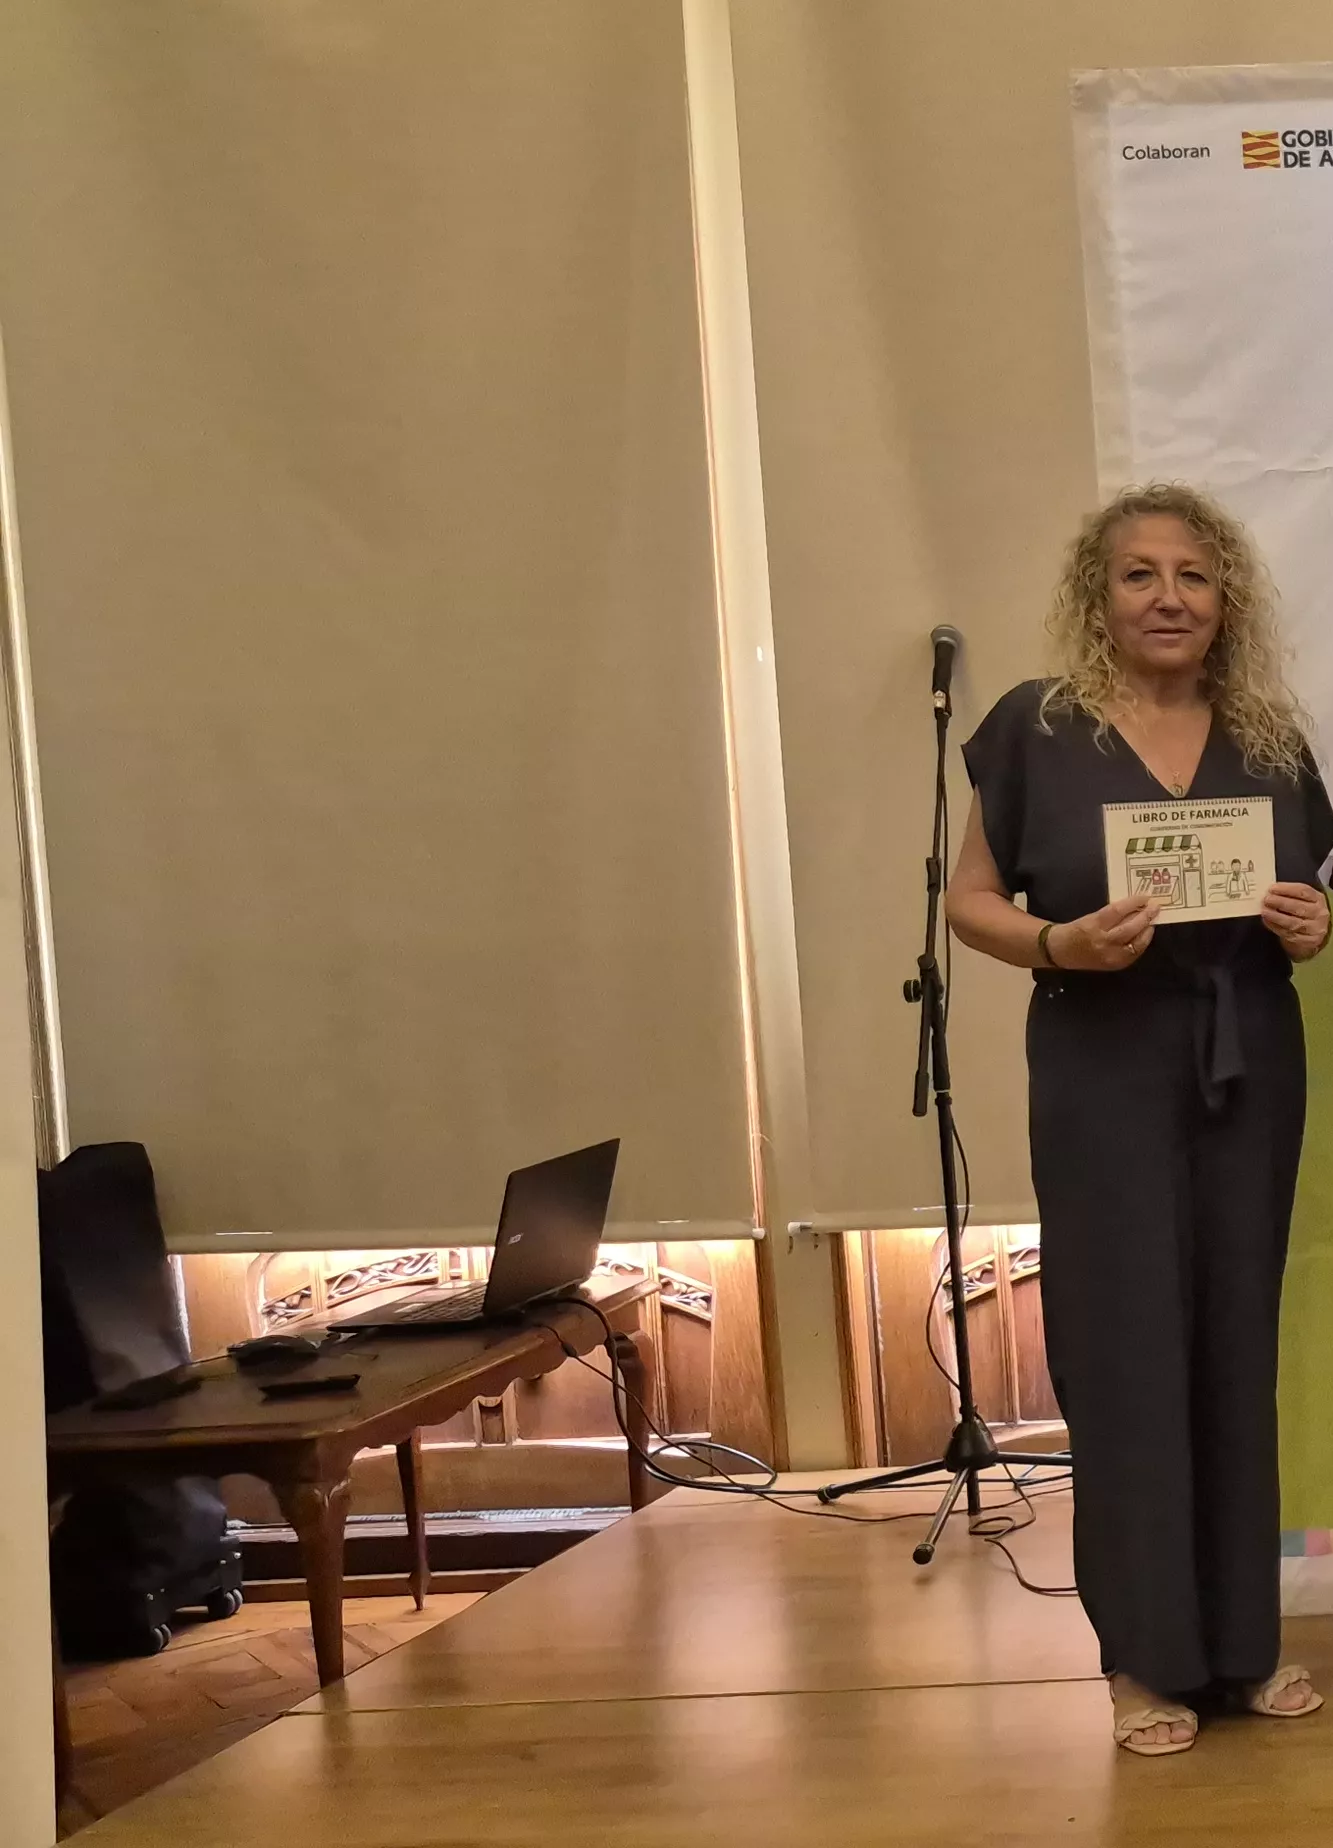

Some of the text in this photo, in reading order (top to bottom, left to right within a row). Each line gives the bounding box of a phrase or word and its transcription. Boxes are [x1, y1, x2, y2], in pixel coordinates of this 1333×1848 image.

[1122, 144, 1211, 160] Colaboran
[1283, 150, 1311, 168] DE
[1132, 807, 1250, 824] LIBRO DE FARMACIA
